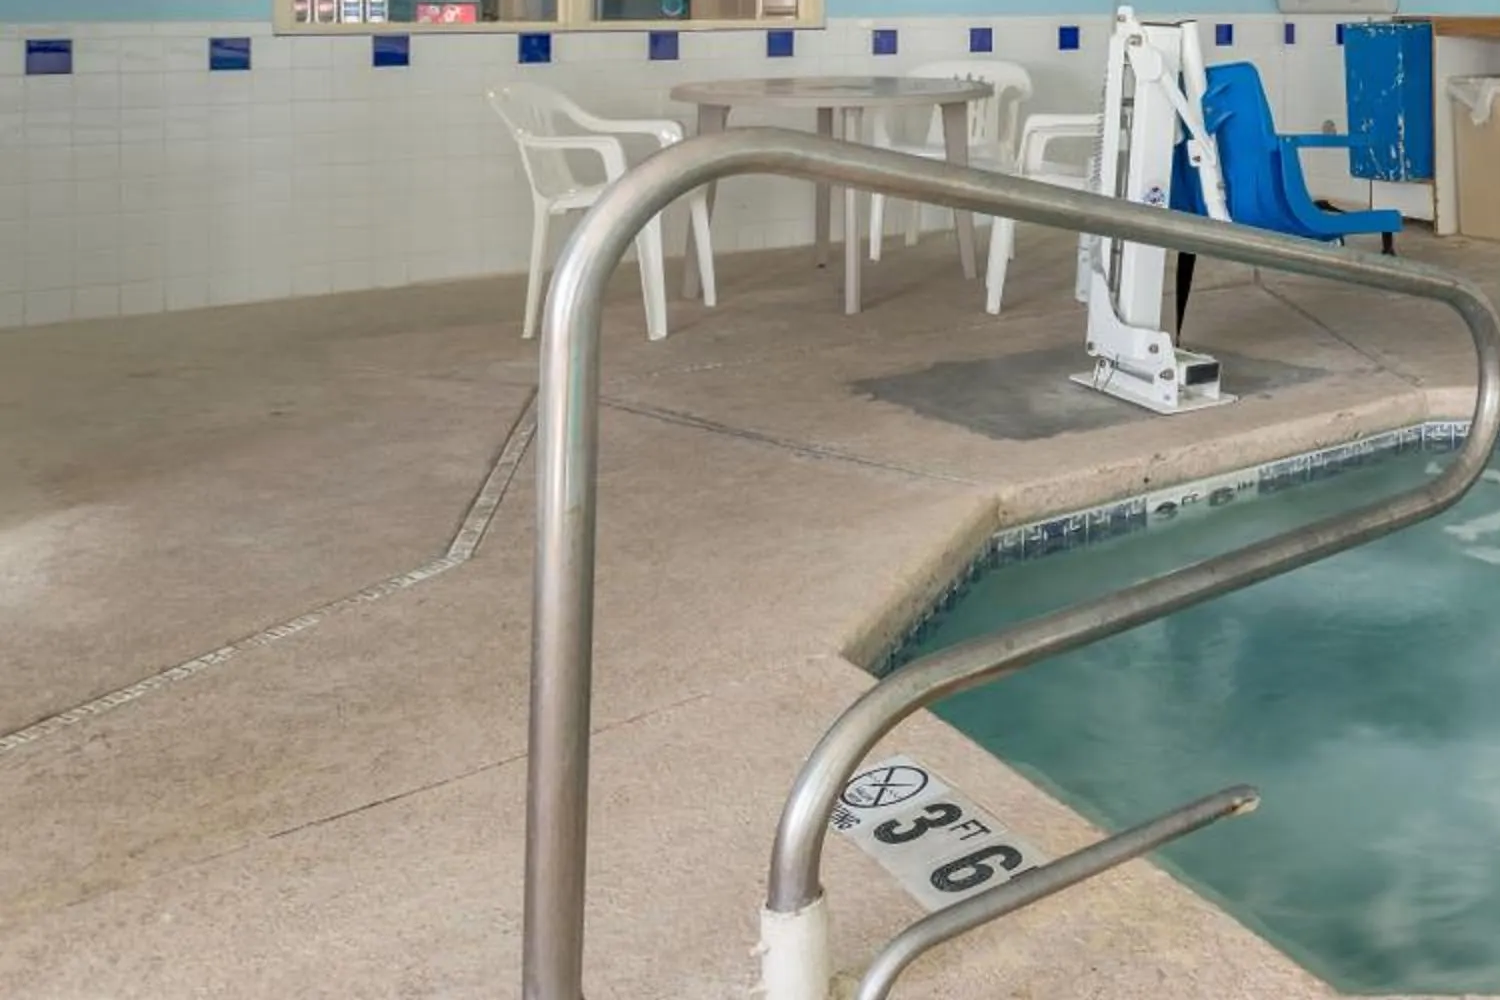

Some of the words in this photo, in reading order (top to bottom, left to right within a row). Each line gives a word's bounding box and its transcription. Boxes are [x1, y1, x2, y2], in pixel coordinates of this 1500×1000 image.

[873, 803, 963, 844] 3
[950, 818, 992, 841] FT
[930, 845, 1024, 892] 6
